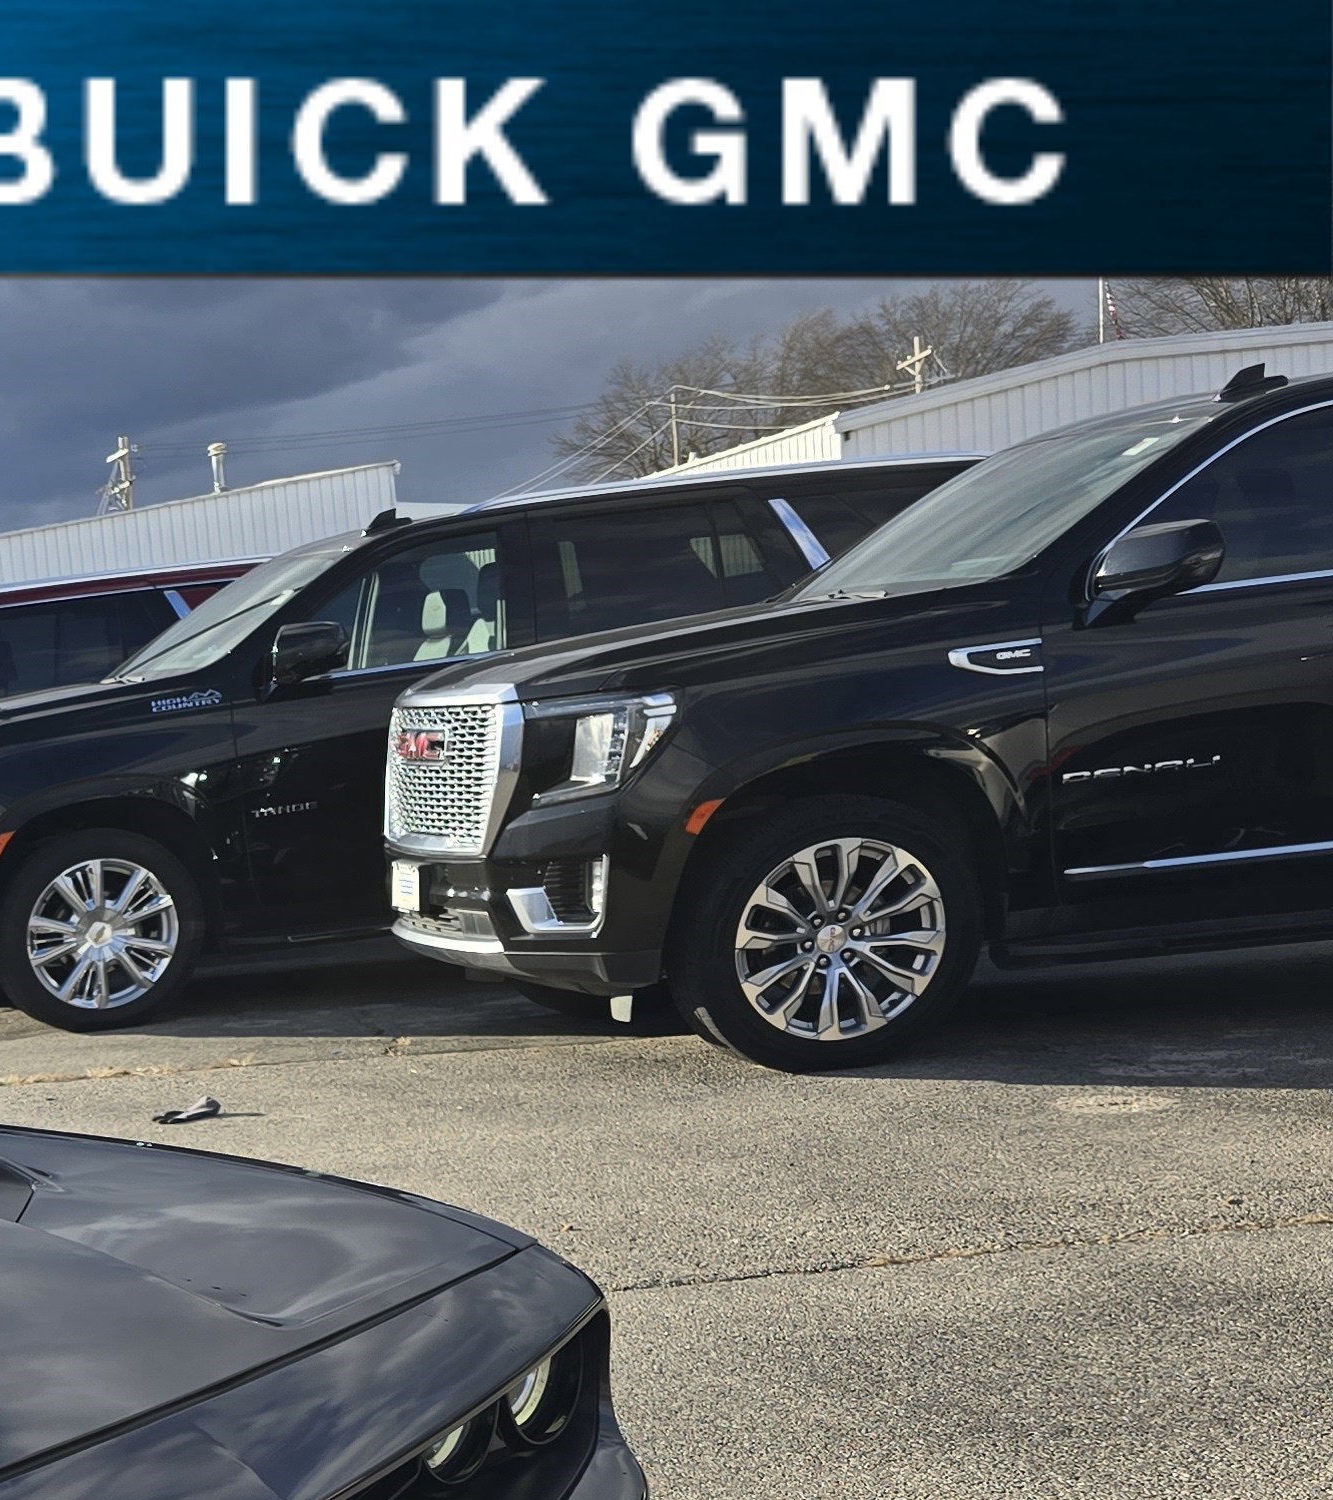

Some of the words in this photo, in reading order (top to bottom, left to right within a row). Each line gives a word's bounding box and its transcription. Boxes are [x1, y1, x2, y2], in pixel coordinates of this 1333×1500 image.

[996, 649, 1031, 660] GMC
[151, 695, 187, 707] HIGH
[151, 698, 221, 713] COUNTRY
[1062, 755, 1221, 784] DENALI
